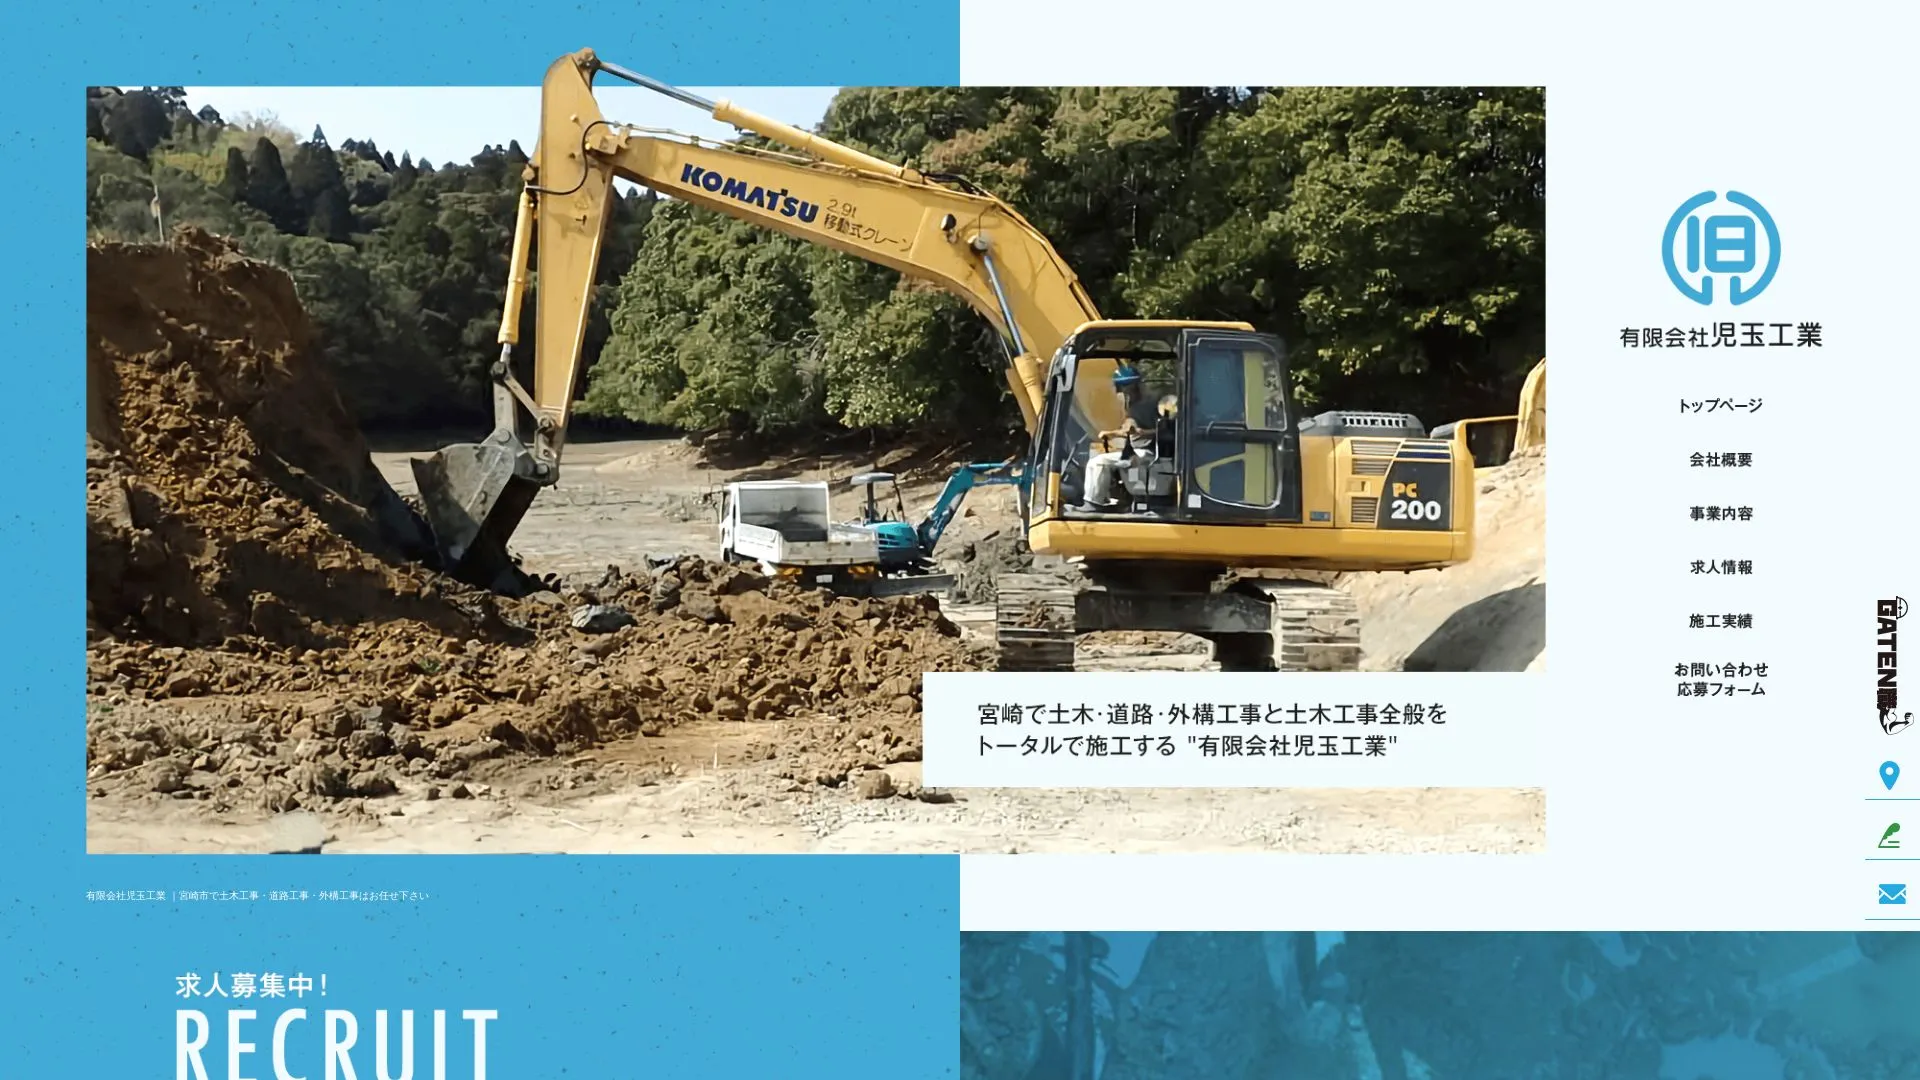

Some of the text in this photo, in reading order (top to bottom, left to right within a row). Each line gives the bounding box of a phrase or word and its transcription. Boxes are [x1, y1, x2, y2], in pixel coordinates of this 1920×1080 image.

[680, 163, 819, 223] KOMATSU
[1392, 482, 1418, 498] PC
[1391, 500, 1442, 521] 200
